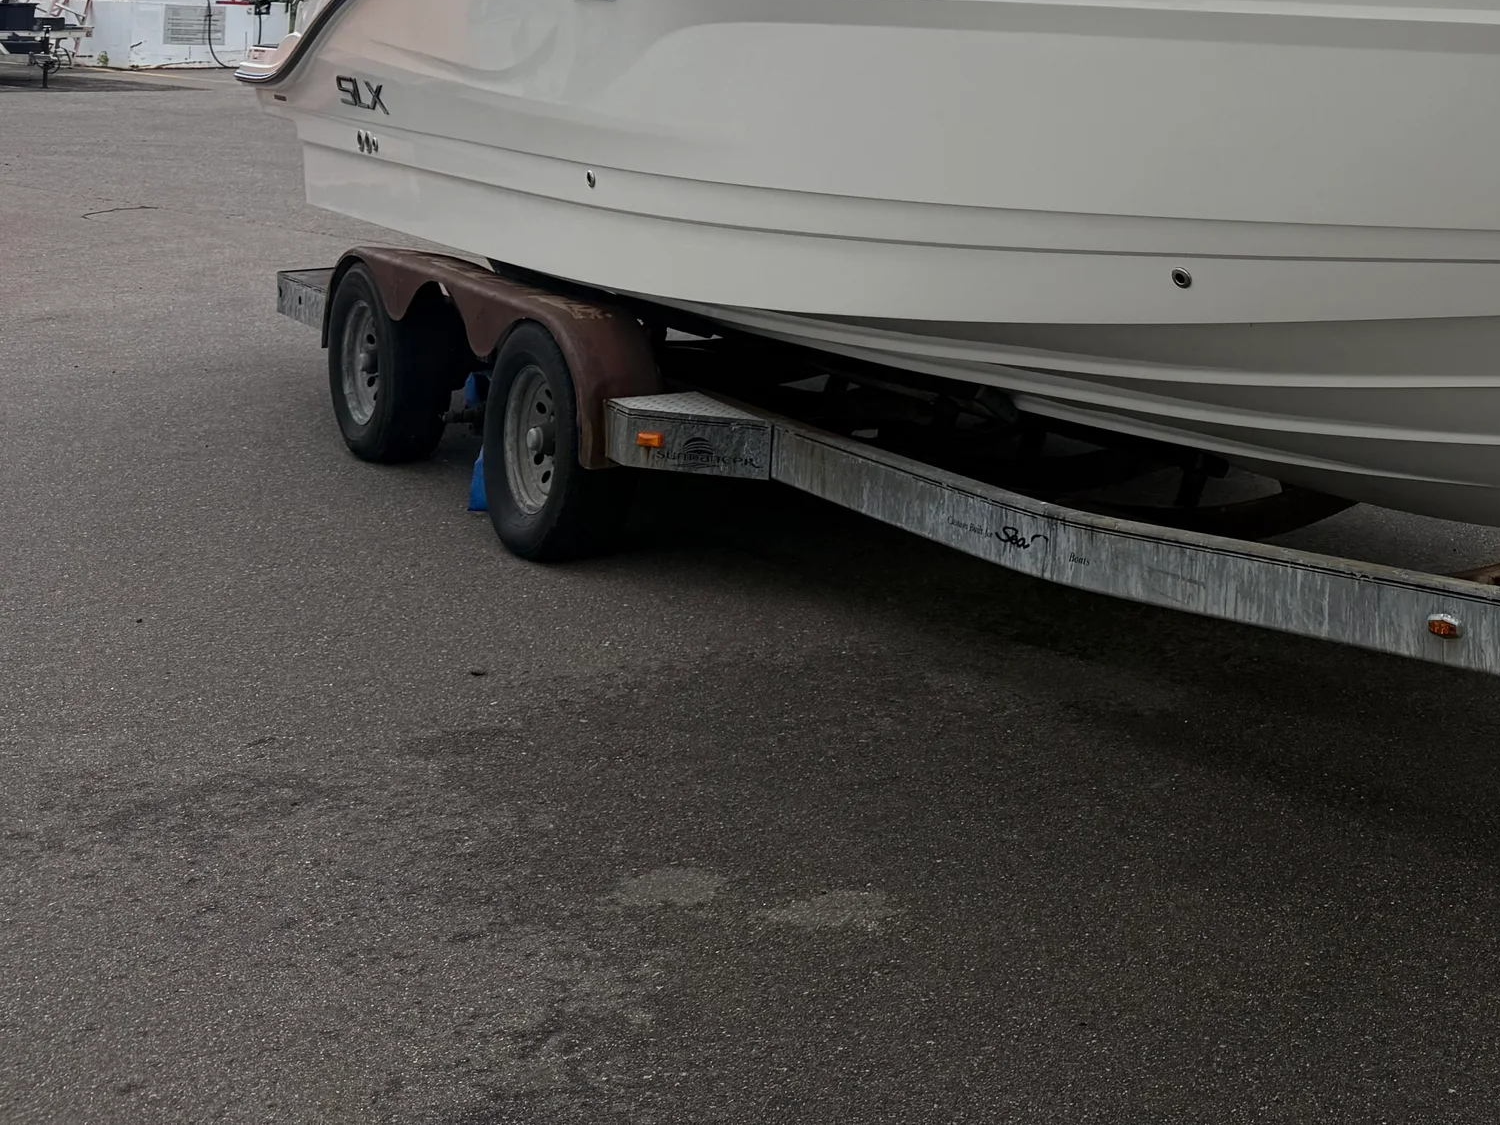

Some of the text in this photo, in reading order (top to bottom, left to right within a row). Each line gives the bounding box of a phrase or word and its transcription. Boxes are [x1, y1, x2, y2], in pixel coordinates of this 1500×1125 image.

[335, 74, 390, 116] SLX
[995, 526, 1030, 550] Sea
[1068, 552, 1091, 567] Boats
